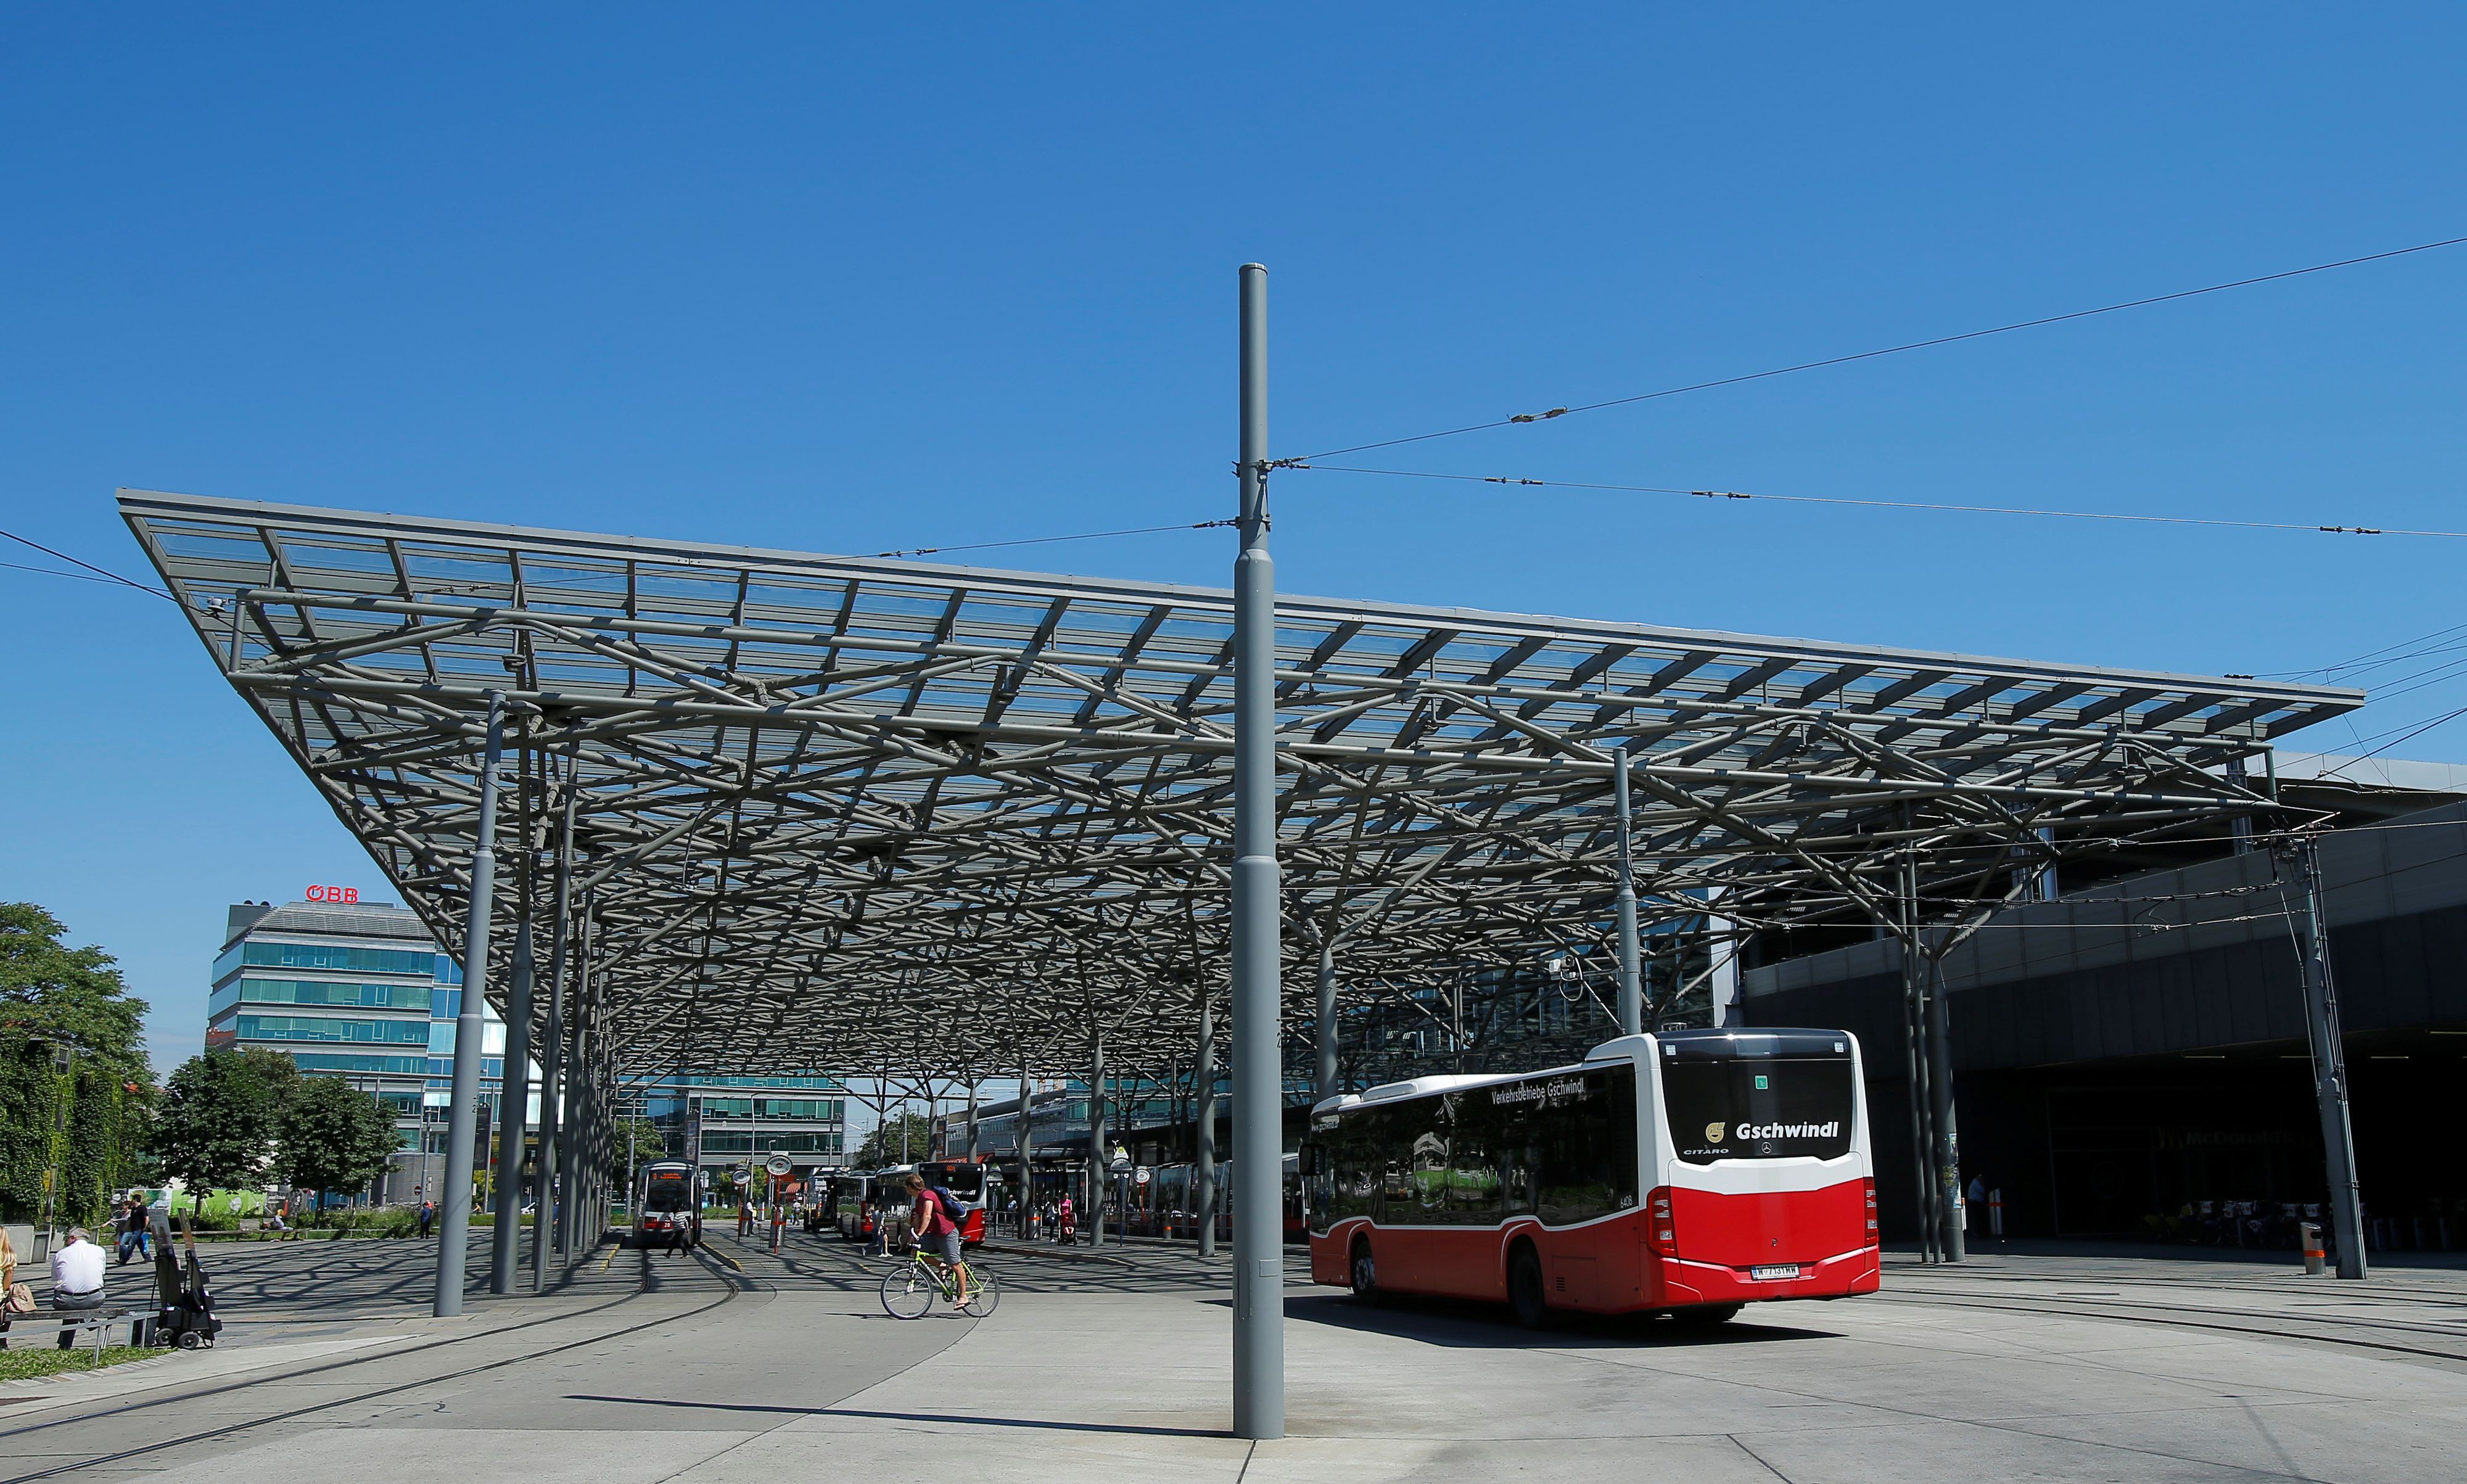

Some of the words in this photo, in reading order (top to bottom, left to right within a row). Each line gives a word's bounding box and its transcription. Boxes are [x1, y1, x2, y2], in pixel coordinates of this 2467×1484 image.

[306, 884, 358, 904] ÖBB
[1492, 1084, 1546, 1105] Verkehrsbetriebe
[1547, 1078, 1584, 1097] Gschwindl
[1736, 1121, 1839, 1140] Gschwindl
[1621, 1195, 1633, 1208] 6408
